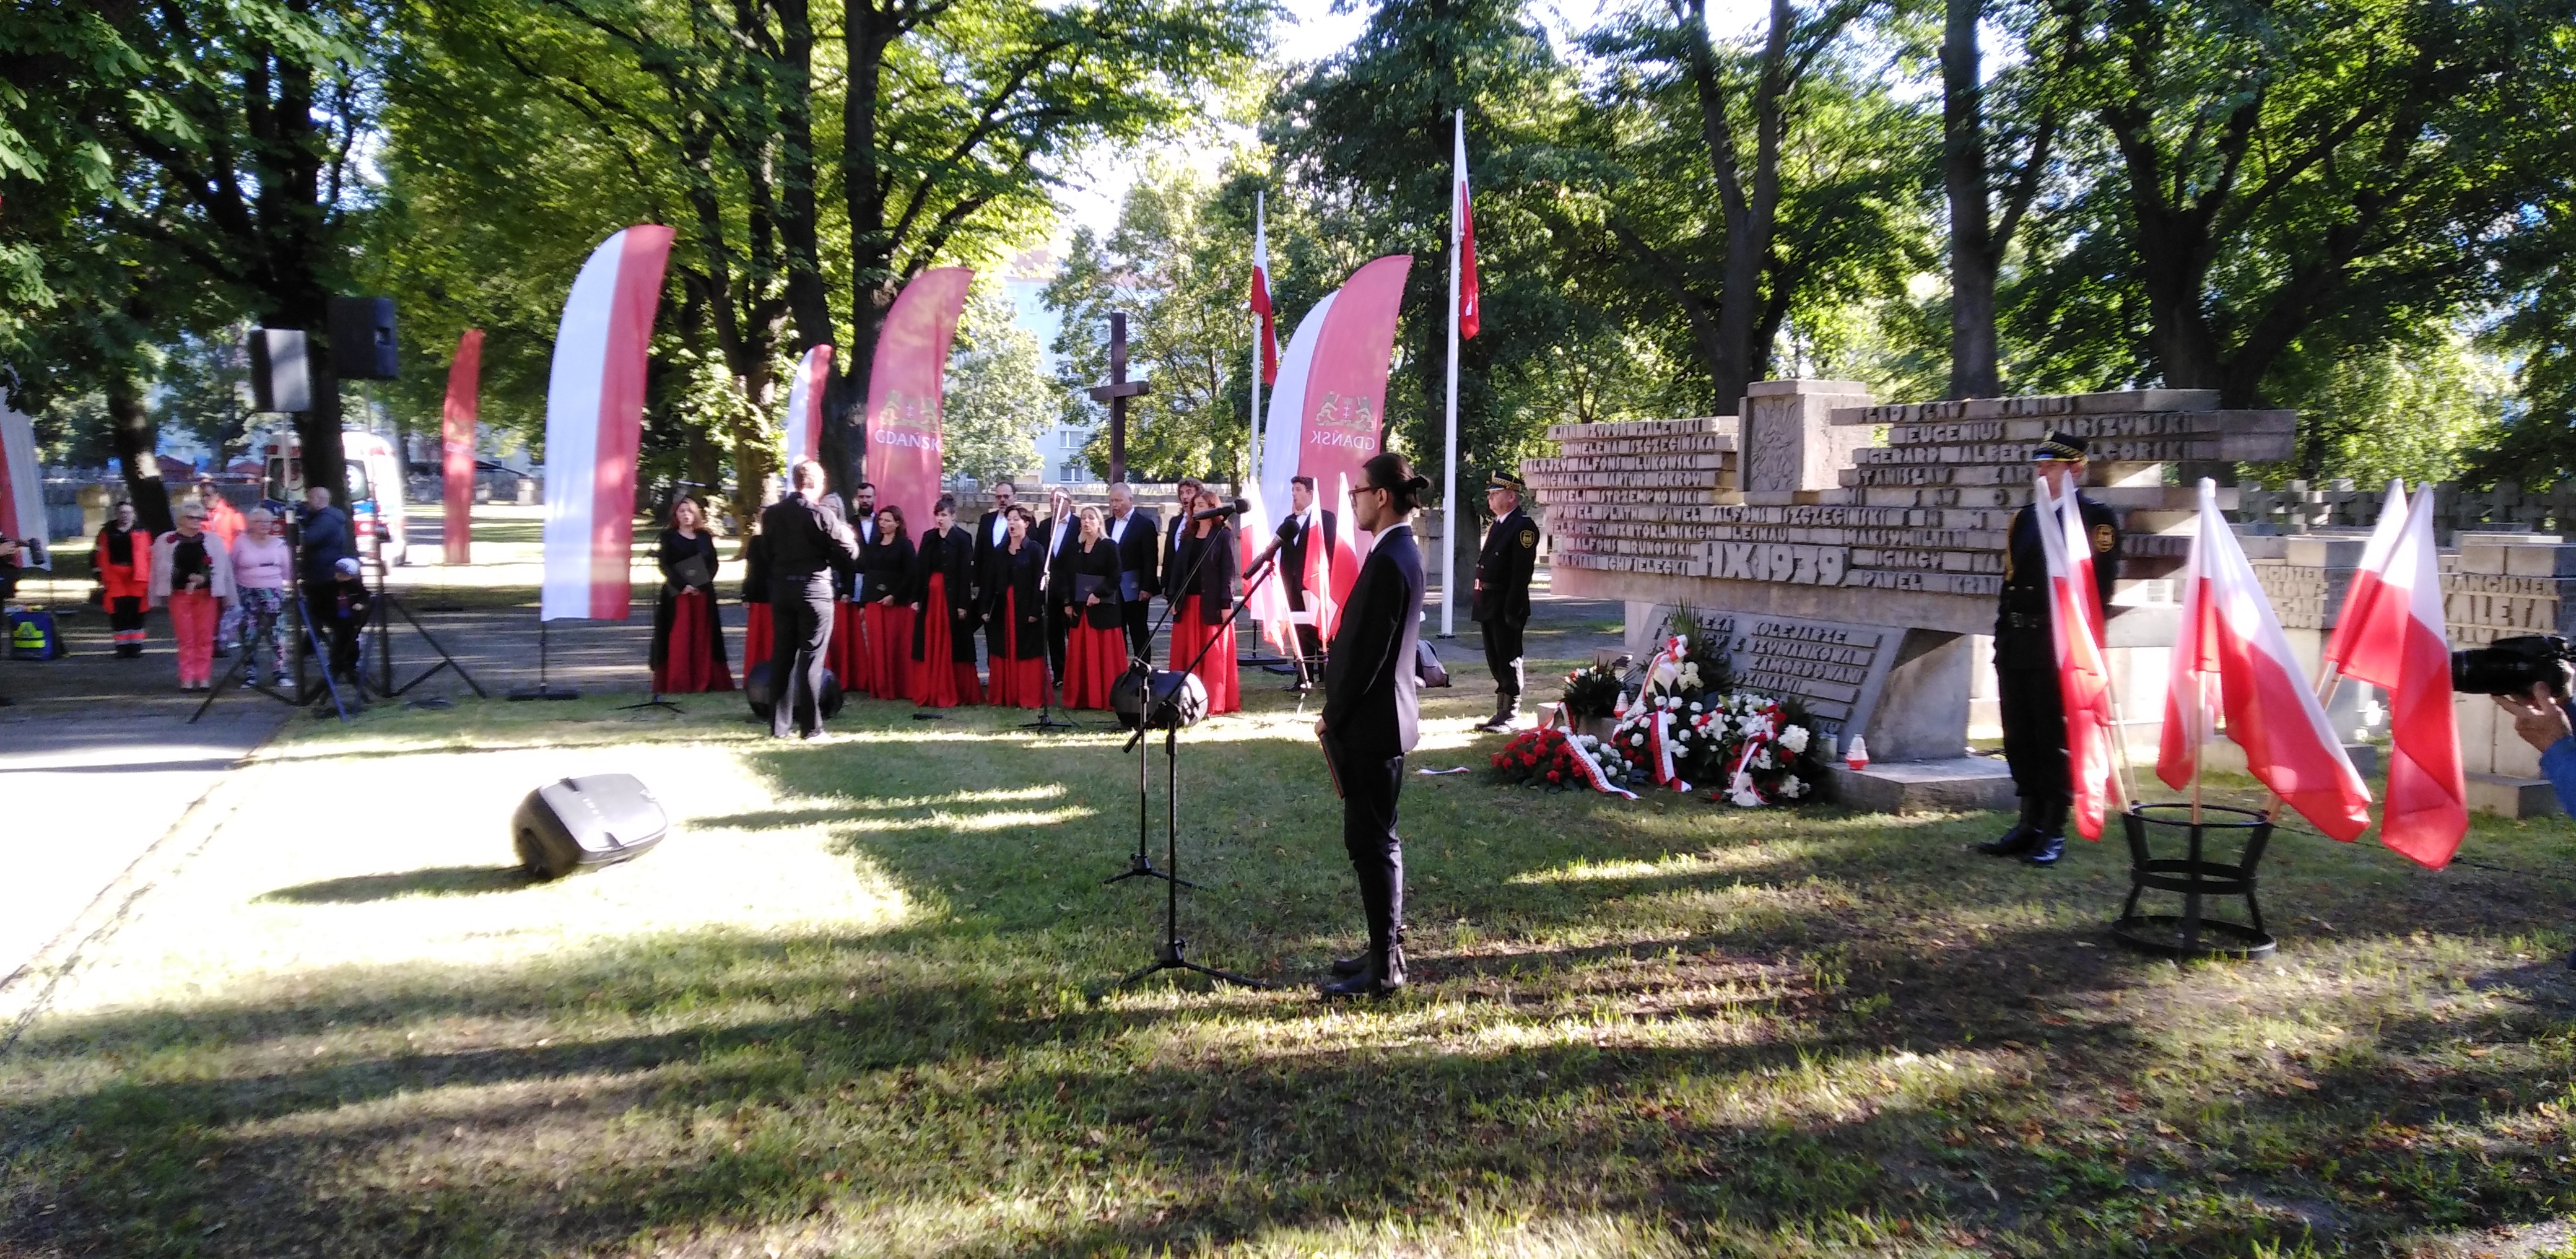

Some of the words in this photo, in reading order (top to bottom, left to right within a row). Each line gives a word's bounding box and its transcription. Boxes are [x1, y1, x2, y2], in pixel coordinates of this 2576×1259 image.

[1556, 424, 1577, 438] JAN
[874, 429, 942, 453] GDAŃSK
[1573, 440, 1619, 456] HELENA
[1868, 447, 1939, 464] GERARD
[1526, 459, 1567, 473] ALOJZY
[1578, 456, 1621, 472] ALFONS
[1608, 472, 1645, 487] ARTUR
[1548, 489, 1586, 503] AURELI
[1603, 506, 1641, 520] PLATH
[1713, 507, 1765, 523] ALFONS
[1575, 537, 1617, 552] ALFONS
[1876, 549, 1942, 569] IGNACY
